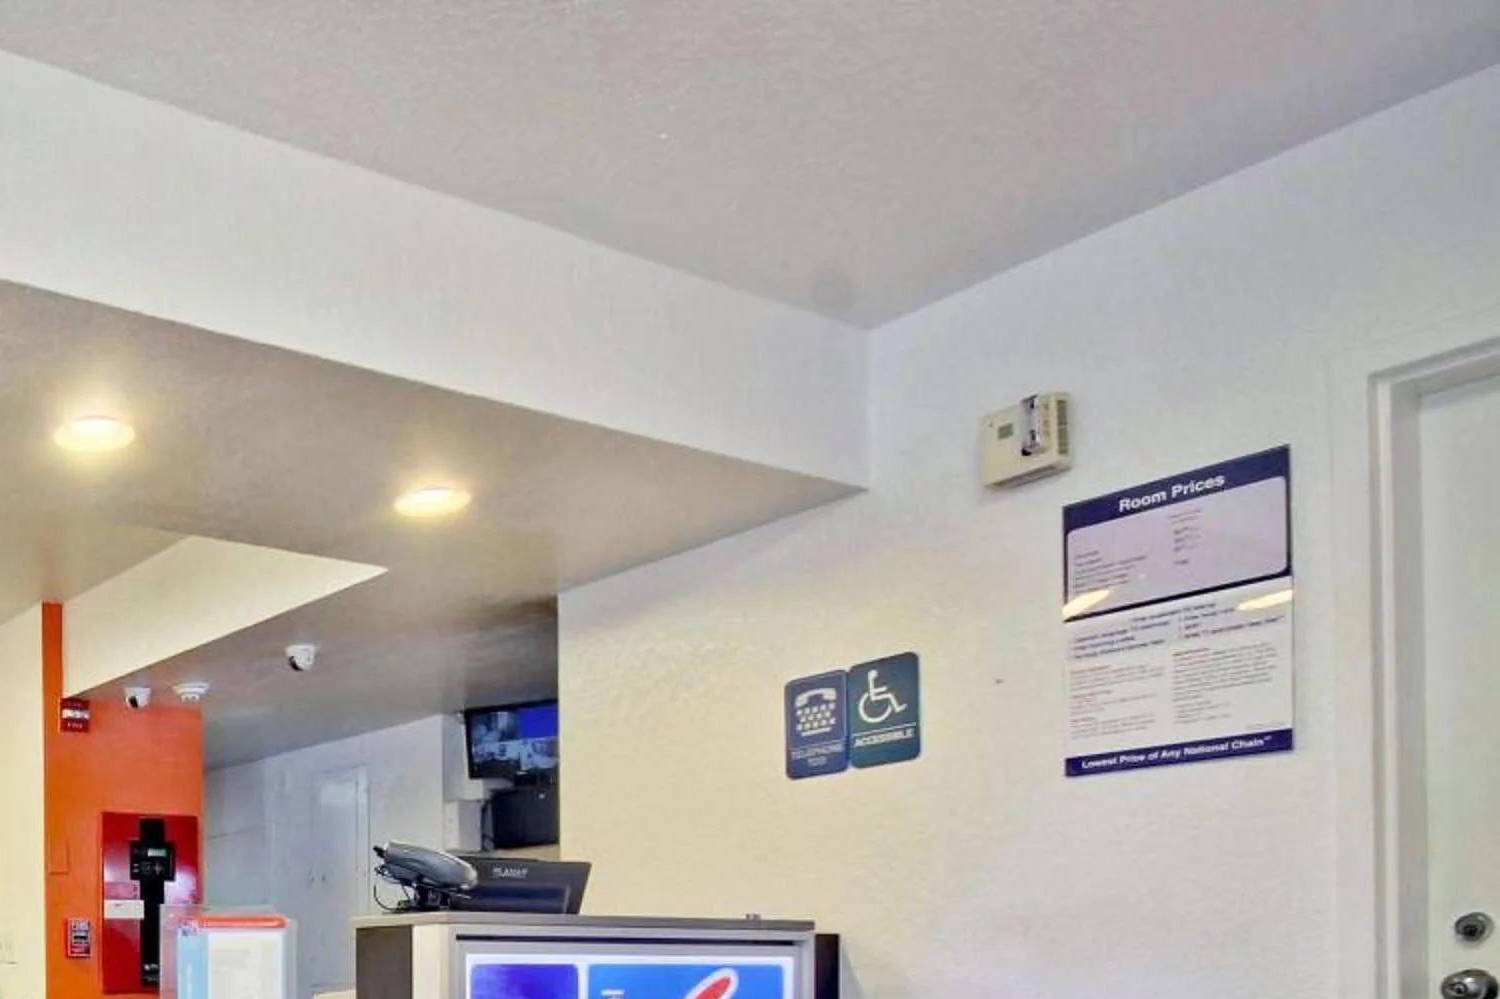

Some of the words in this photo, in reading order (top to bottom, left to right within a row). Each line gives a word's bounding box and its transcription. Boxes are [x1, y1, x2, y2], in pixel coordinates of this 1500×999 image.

[1119, 491, 1167, 513] Room
[1171, 475, 1226, 499] Prices
[1161, 749, 1181, 760] Any
